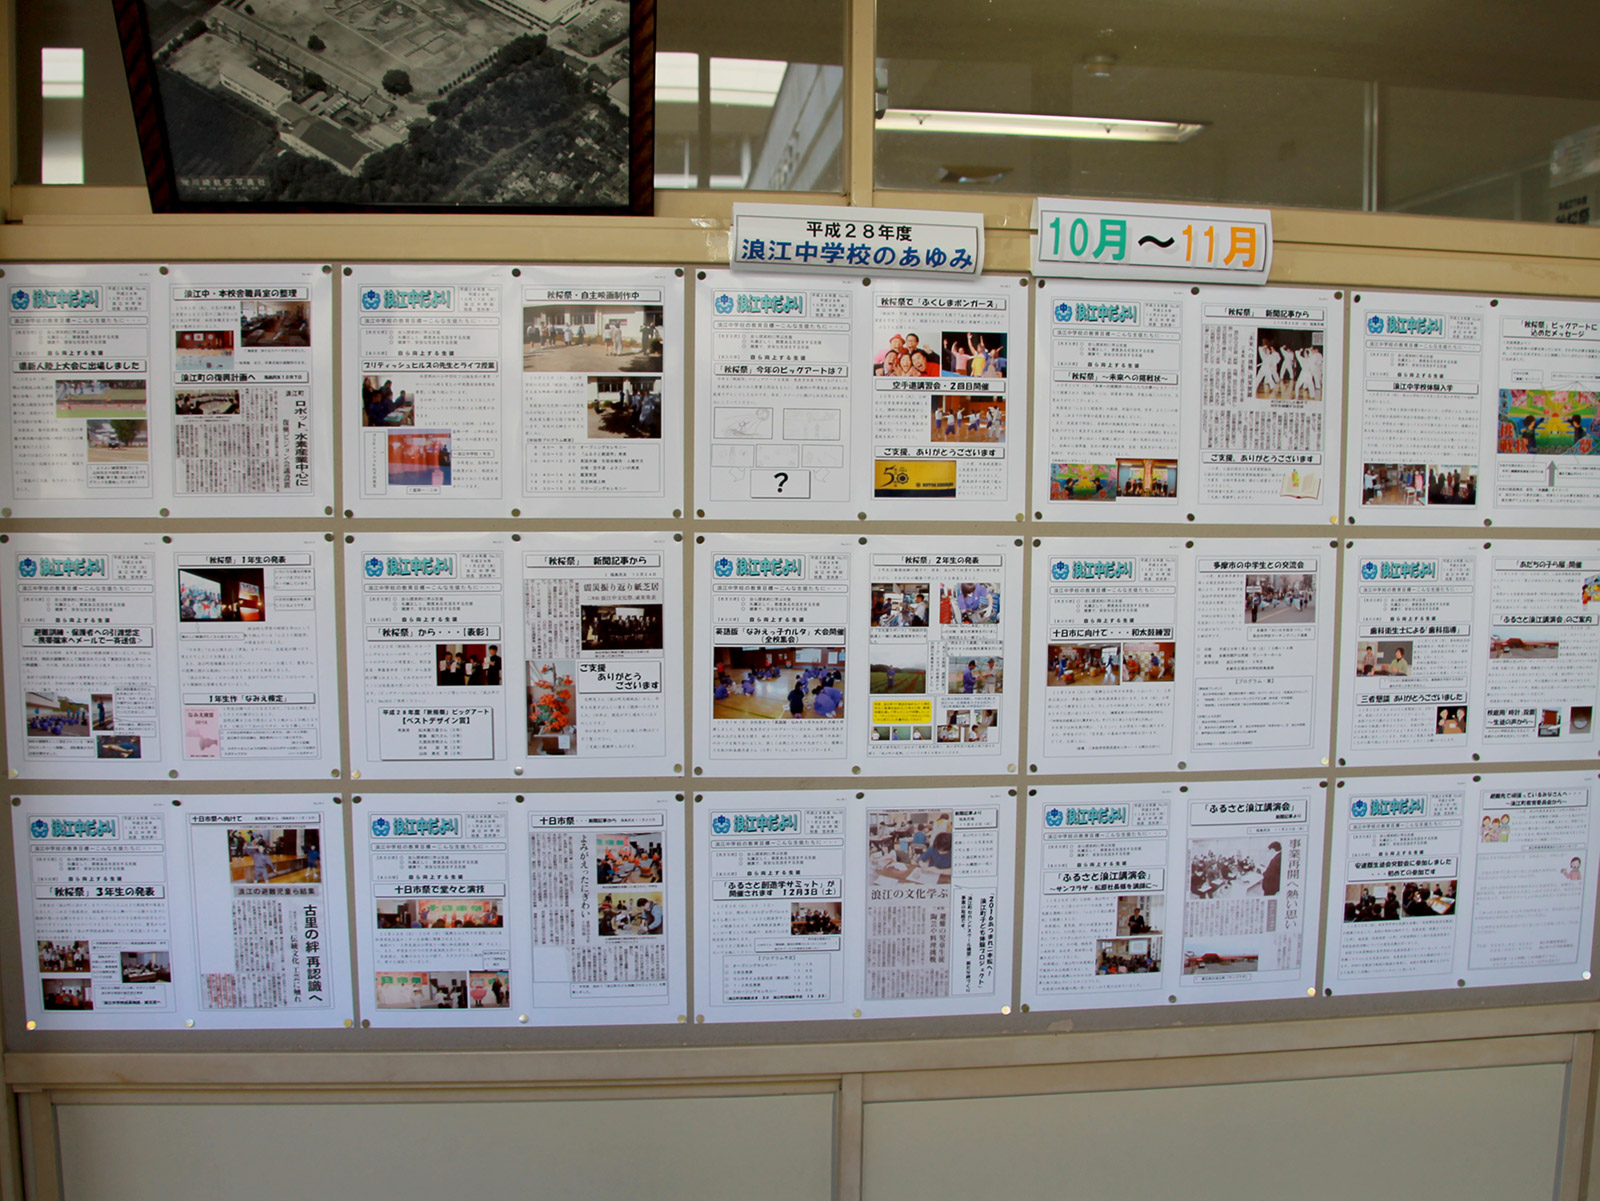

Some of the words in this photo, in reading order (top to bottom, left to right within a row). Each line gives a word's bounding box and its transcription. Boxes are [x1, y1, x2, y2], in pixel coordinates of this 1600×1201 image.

[741, 238, 974, 271] 浪江中学校のあゆみ
[32, 289, 98, 309] 浪江中だより
[185, 290, 297, 298] 浪江中・本校舎職員室の整理
[384, 289, 450, 309] 浪江中だより
[547, 291, 639, 300] 秋桜祭・自主映画制作中
[737, 294, 802, 314] 浪江中だより
[1075, 302, 1137, 323] 浪江中だより
[1266, 309, 1309, 318] 新聞記事から
[1387, 315, 1442, 335] 浪江中だより
[1530, 329, 1584, 337] 込めたメッセージ
[19, 362, 140, 370] 県新人陸上大会に出場しました
[1393, 382, 1453, 391] 浪江中学校体験入学
[884, 448, 996, 457] ご支援、ありがとうございます
[1210, 454, 1313, 463] ご支援、ありがとうございます
[205, 556, 286, 564] 「秋桜祭」1年生の発表
[544, 556, 580, 566] 「秋桜祭」
[593, 556, 647, 565] 新聞記事から
[901, 556, 979, 564] 「秋桜祭」2年生の発表
[1213, 561, 1304, 570] 多摩市の中学生との交流会
[40, 557, 105, 577] 浪江中だより
[386, 556, 453, 576] 浪江中だより
[736, 557, 801, 576] 浪江中だより
[1072, 561, 1132, 579] 浪江中だより
[1380, 561, 1436, 579] 浪江中だより
[583, 582, 659, 592] 震災振り返り紙芝居
[580, 664, 606, 672] ご支援
[597, 673, 642, 681] ありがとう
[615, 682, 659, 690] ございます
[1393, 694, 1463, 702] ありがとうございました
[402, 717, 470, 725] 【ベストデザイン賞】
[1204, 802, 1295, 814] 「ふるさと浪江講演会」
[1370, 798, 1425, 816] 浪江中だより
[1066, 807, 1126, 825] 浪江中だより
[51, 819, 116, 837] 浪江中だより
[393, 817, 458, 836] 浪江中だより
[734, 814, 797, 832] 浪江中だより
[579, 835, 591, 918] よみがえったにぎわい
[1057, 870, 1151, 882] 「ふるさと浪江講演会」
[1284, 838, 1302, 929] 事業再開へ熱い思い
[49, 887, 155, 897] 「秋桜祭」3年生の発表
[394, 885, 485, 894] 十日市祭で堂々と演技
[729, 889, 773, 897] 開催されます
[871, 889, 948, 900] 浪江の文化学ぶ
[303, 904, 320, 953] 古里の絆
[306, 956, 323, 1002] 再認識へ
